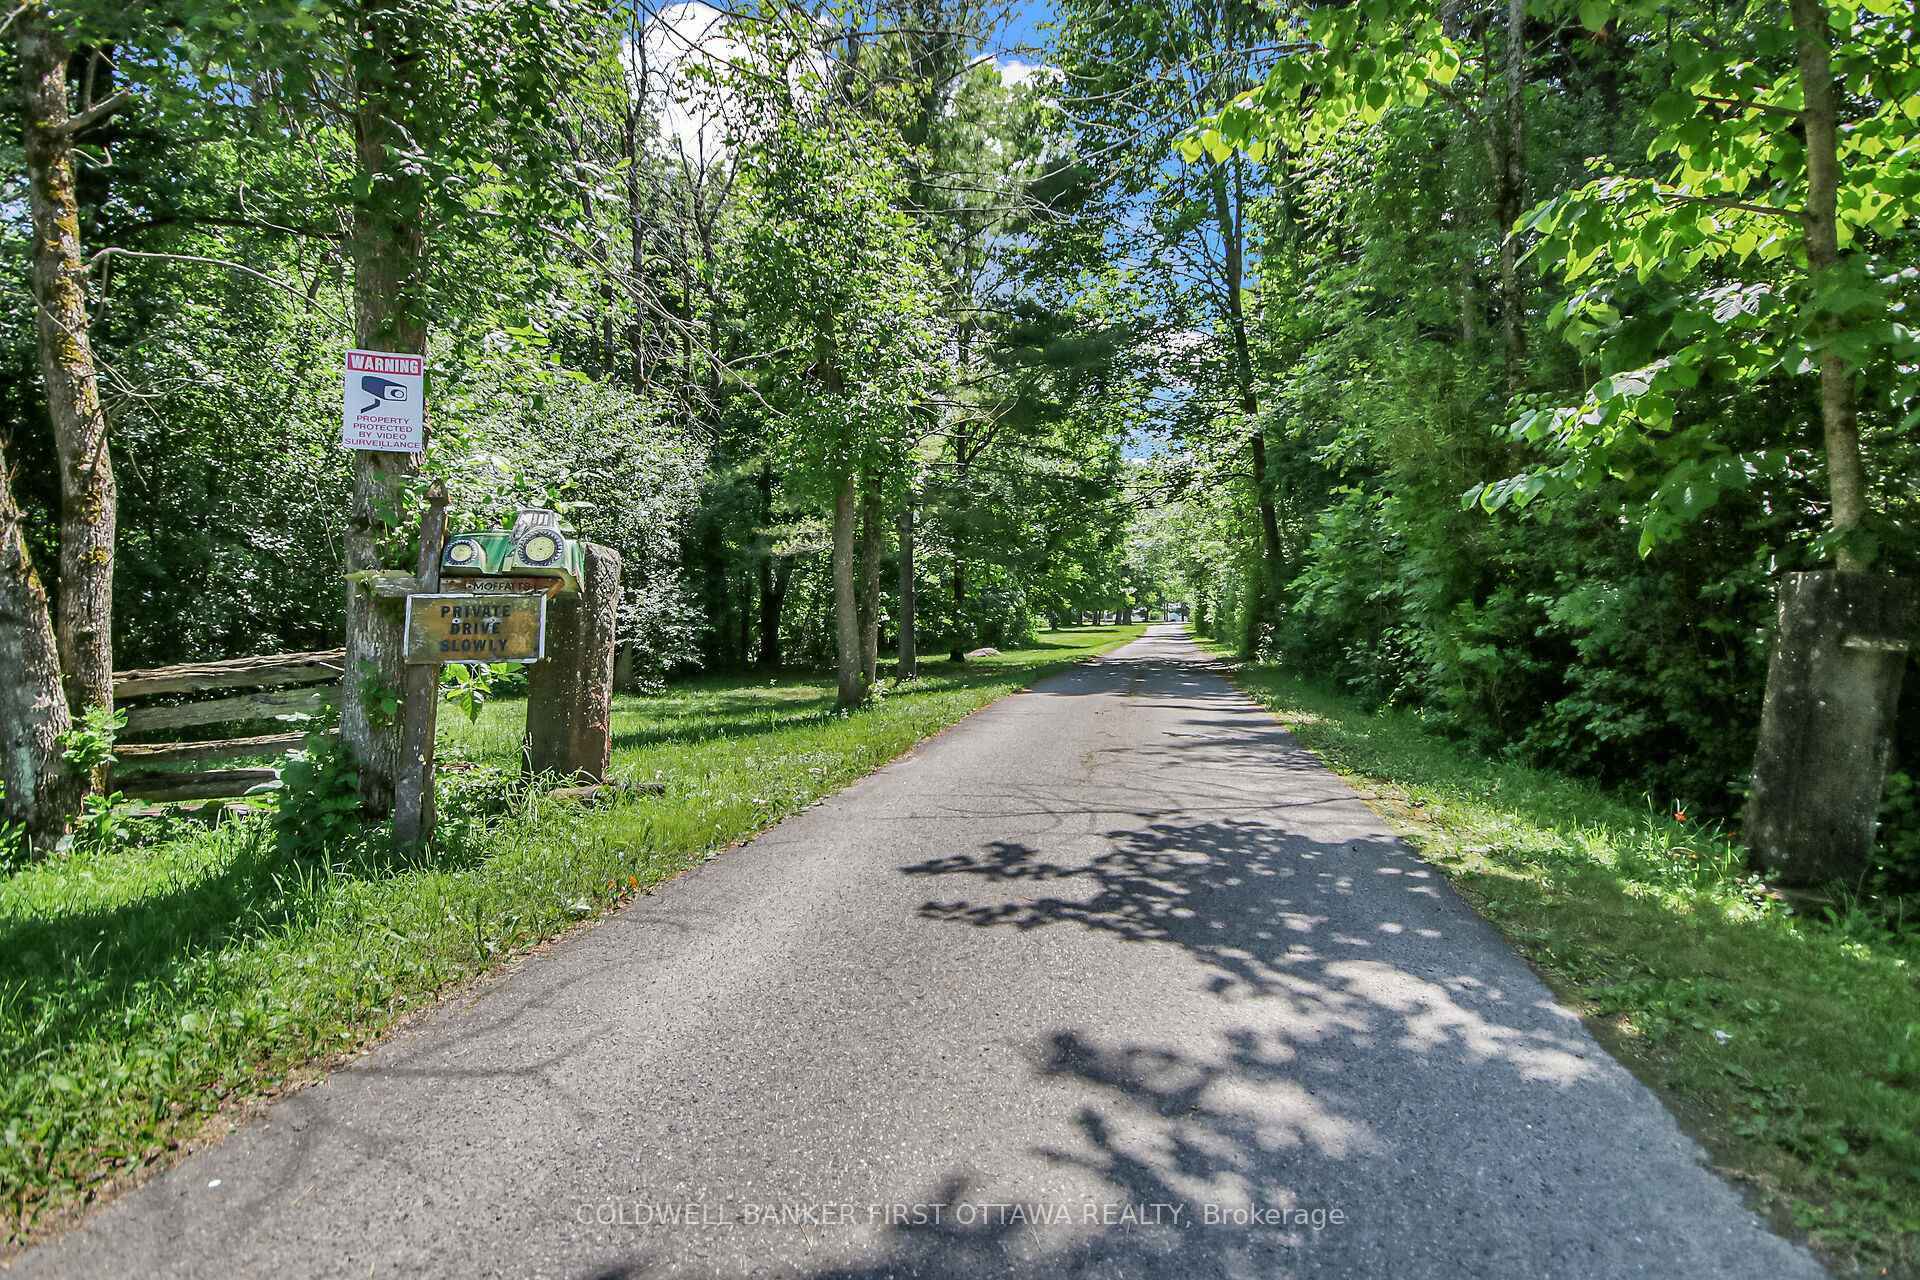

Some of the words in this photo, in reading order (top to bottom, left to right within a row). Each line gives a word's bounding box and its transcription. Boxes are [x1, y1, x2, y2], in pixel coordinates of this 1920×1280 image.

[350, 354, 419, 374] WARNING
[356, 415, 410, 425] PROPERTY
[353, 422, 413, 433] PROTECTED
[376, 432, 407, 441] VIDEO
[344, 438, 420, 449] SURVEILLANCE
[440, 605, 512, 618] PRIVATE
[450, 622, 500, 635] DRIVE
[440, 639, 508, 652] SLOWLY
